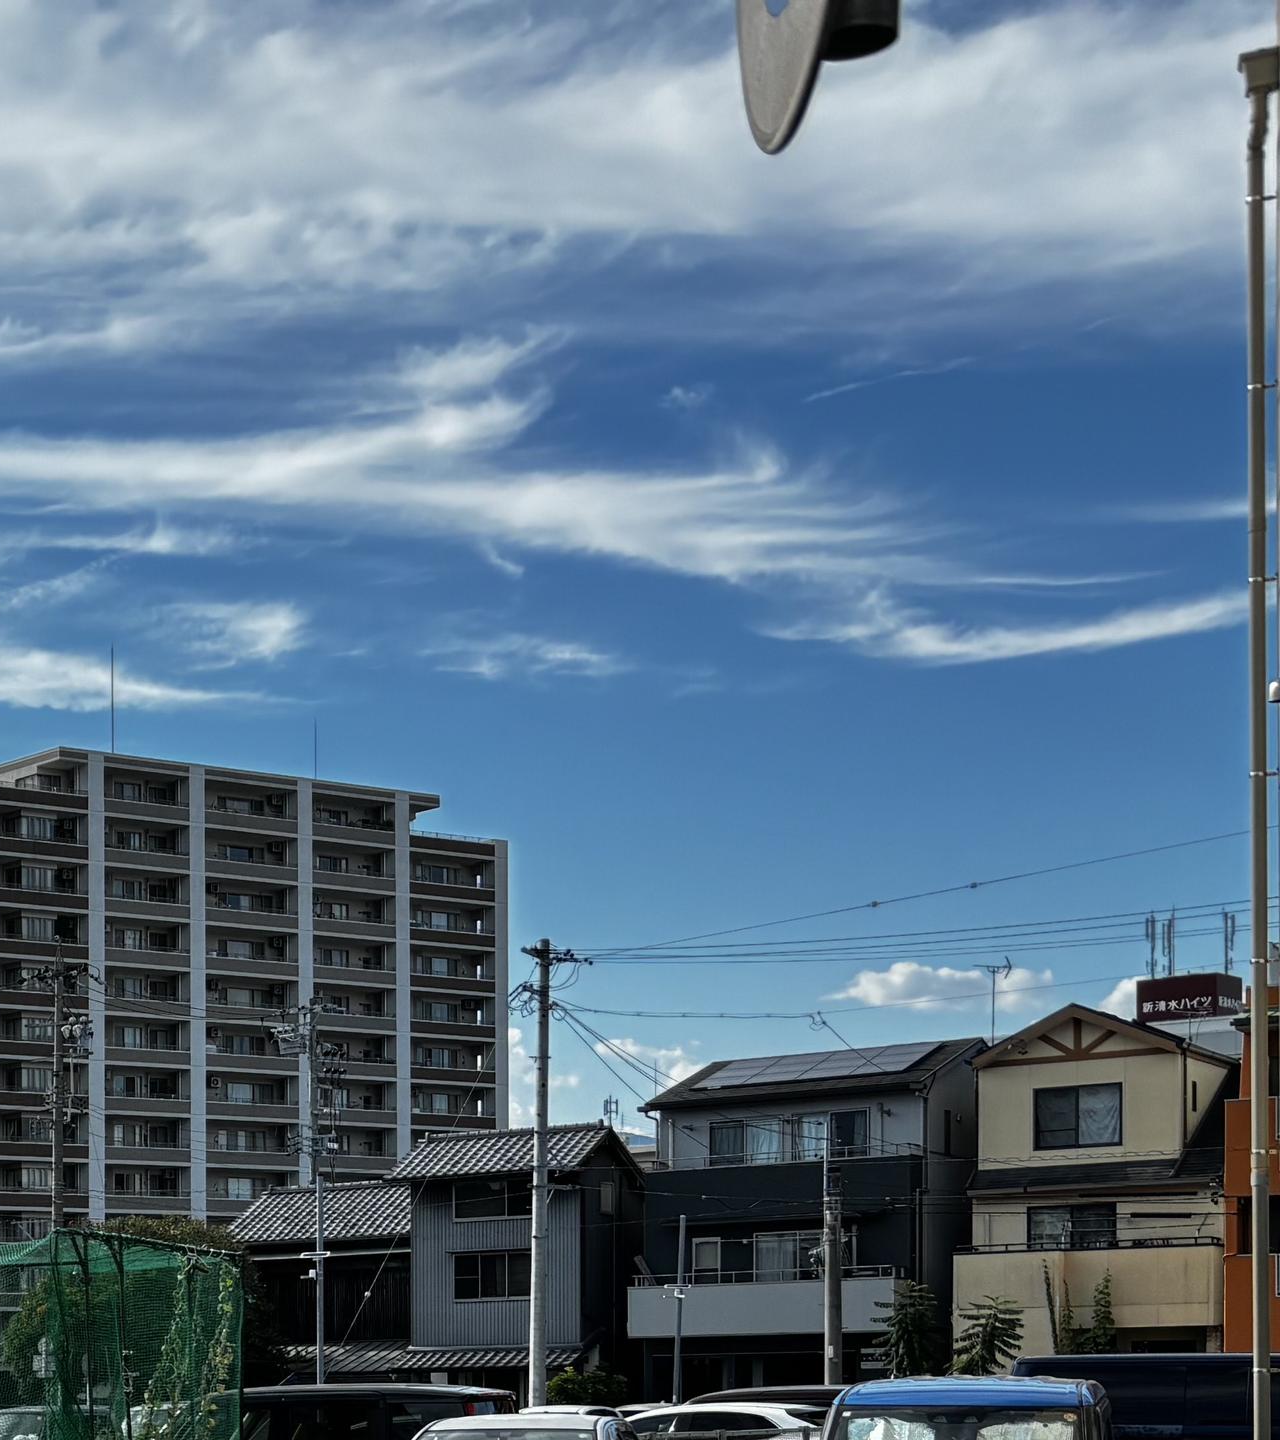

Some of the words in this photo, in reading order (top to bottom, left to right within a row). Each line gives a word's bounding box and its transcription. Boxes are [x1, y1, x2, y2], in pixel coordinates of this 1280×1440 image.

[1142, 996, 1211, 1012] 新清水ハイツ
